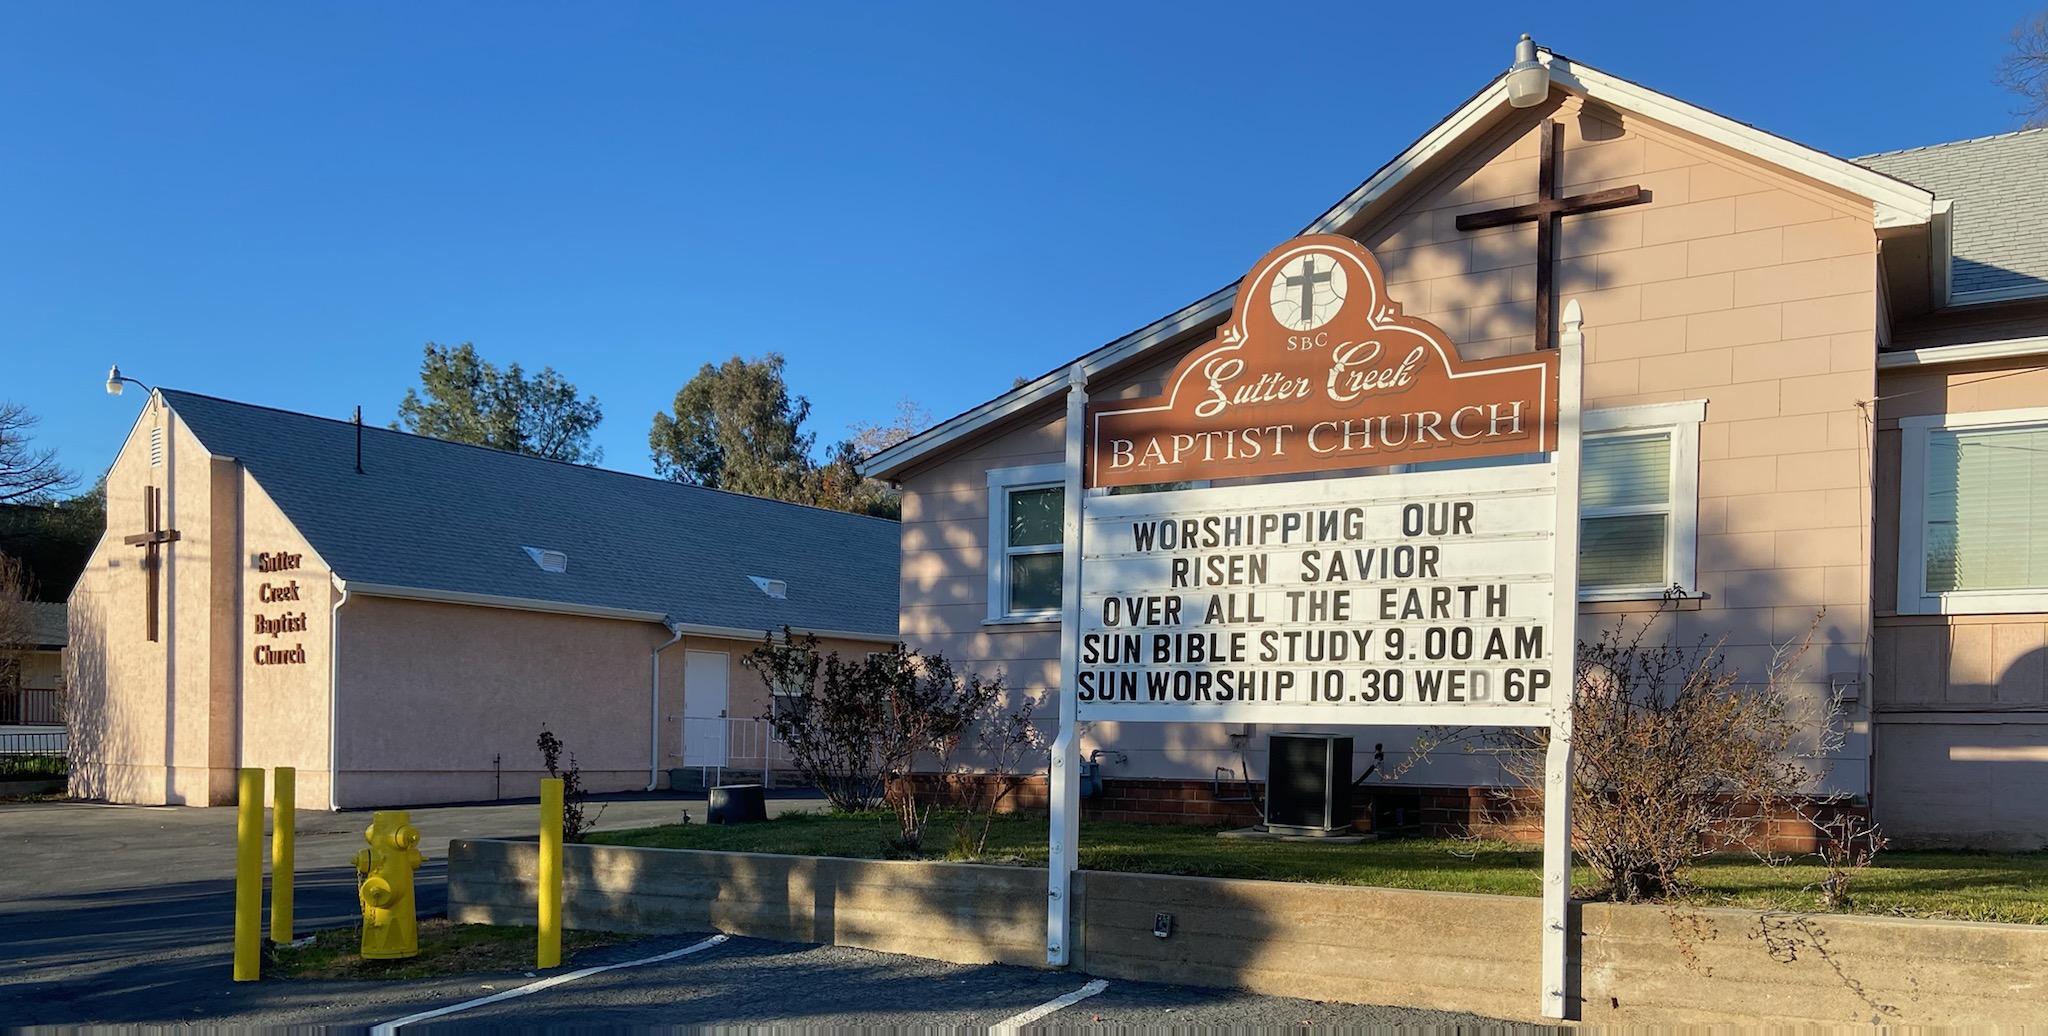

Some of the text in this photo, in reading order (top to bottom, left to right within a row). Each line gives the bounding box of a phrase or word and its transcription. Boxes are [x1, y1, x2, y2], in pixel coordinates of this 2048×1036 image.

[1286, 331, 1329, 351] SBC
[1194, 340, 1425, 418] Sutter Creek
[1109, 400, 1526, 470] BAPTIST CHURCH
[1133, 501, 1475, 553] WORSHIPPING OUR
[258, 551, 302, 573] Sutter
[1171, 545, 1440, 588] RISEN SAVIOR
[258, 580, 300, 603] Creek
[1103, 584, 1508, 627] OVER ALL THE EARTH
[254, 611, 307, 638] Baptist
[253, 643, 306, 665] Church
[1082, 625, 1543, 664] SUN BIBLE STUDY 9.00 AM
[1078, 668, 1551, 702] SUN WORSHIP 10.30 WED 6P
